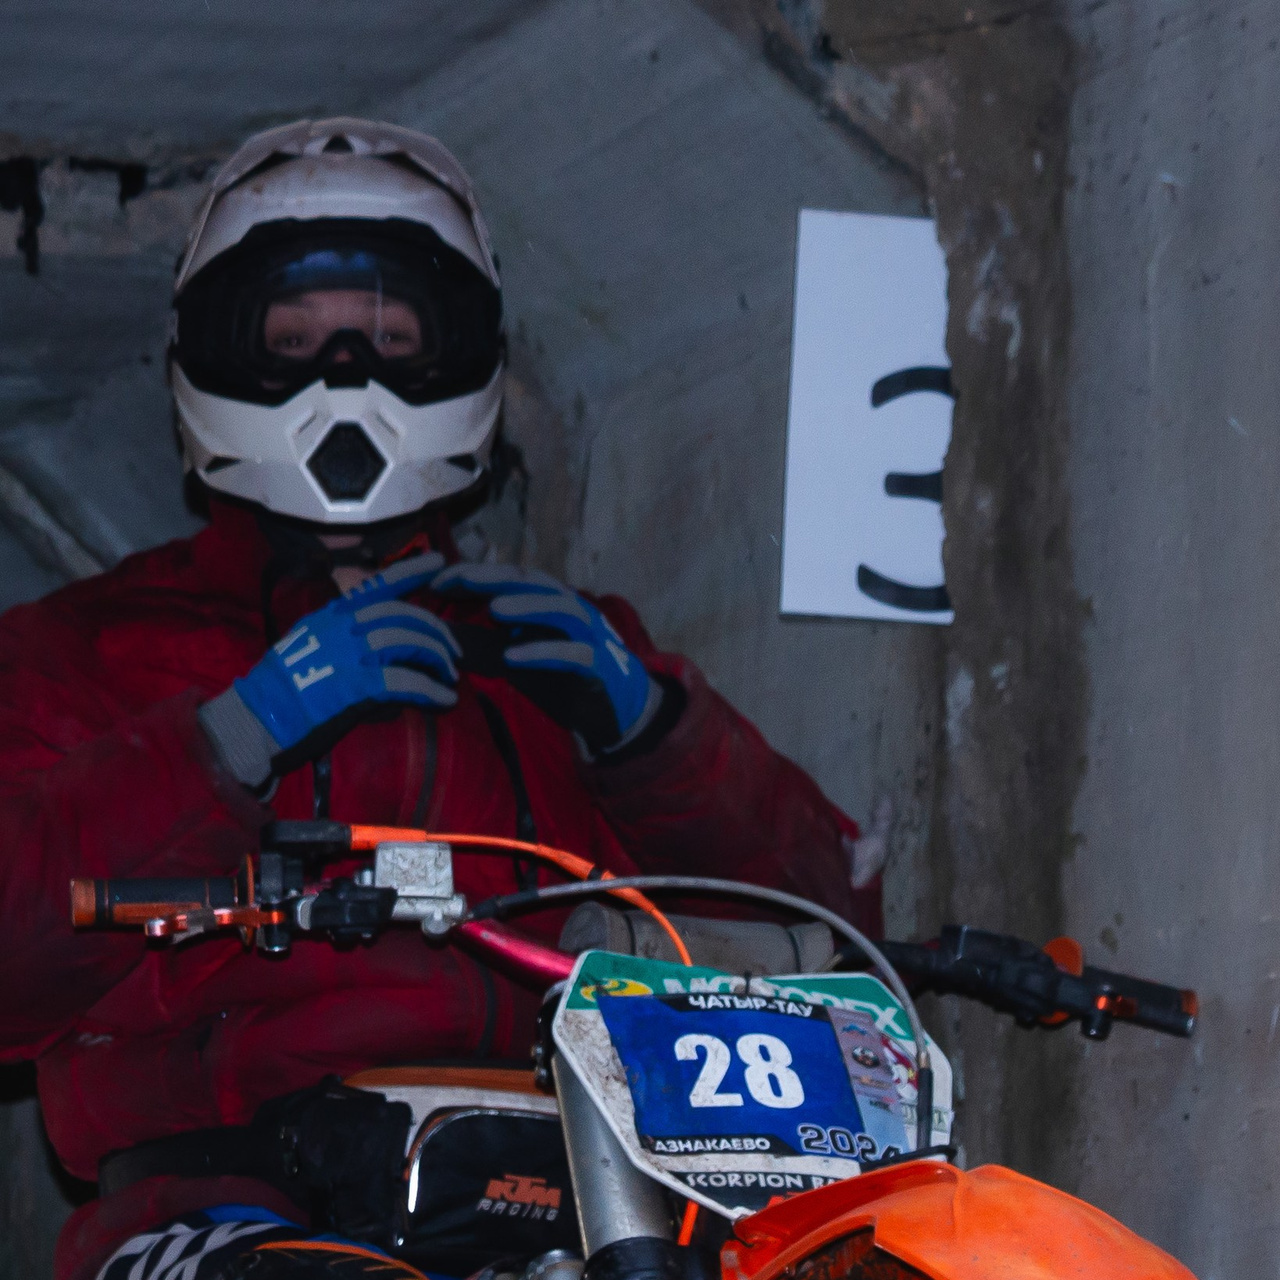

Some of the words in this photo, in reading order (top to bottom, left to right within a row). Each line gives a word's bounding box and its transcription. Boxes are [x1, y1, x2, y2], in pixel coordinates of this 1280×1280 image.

[688, 994, 814, 1018] ЧАТЫР-ТАУ
[674, 1033, 805, 1110] 28
[654, 1136, 771, 1153] АЗНАКАЕВО
[485, 1174, 563, 1210] KTM
[685, 1172, 804, 1190] SCORPION
[476, 1198, 560, 1221] RACING
